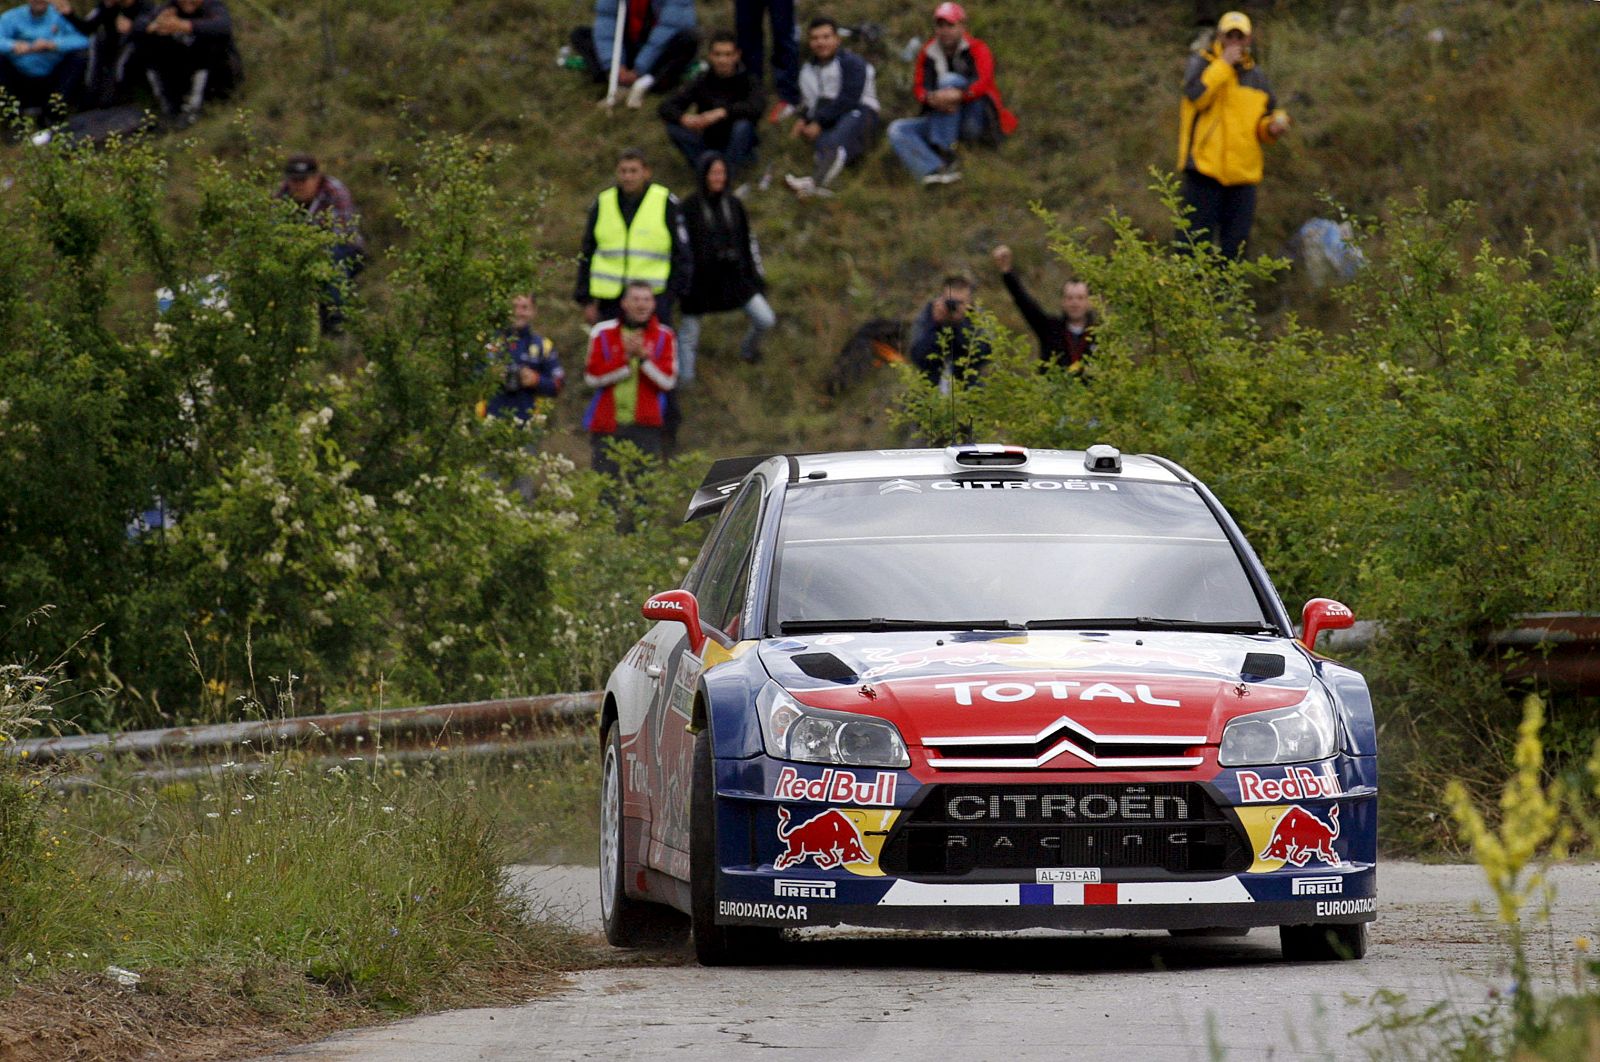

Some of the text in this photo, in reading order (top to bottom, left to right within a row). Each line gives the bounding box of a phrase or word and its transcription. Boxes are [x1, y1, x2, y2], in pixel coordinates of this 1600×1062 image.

[647, 600, 683, 610] TOTAL
[935, 680, 1181, 708] TOTAL
[1041, 870, 1097, 881] AL-791-AR
[774, 879, 836, 898] PIRELLI
[1292, 876, 1343, 895] PIRELLI
[719, 900, 808, 920] EURODATACAR
